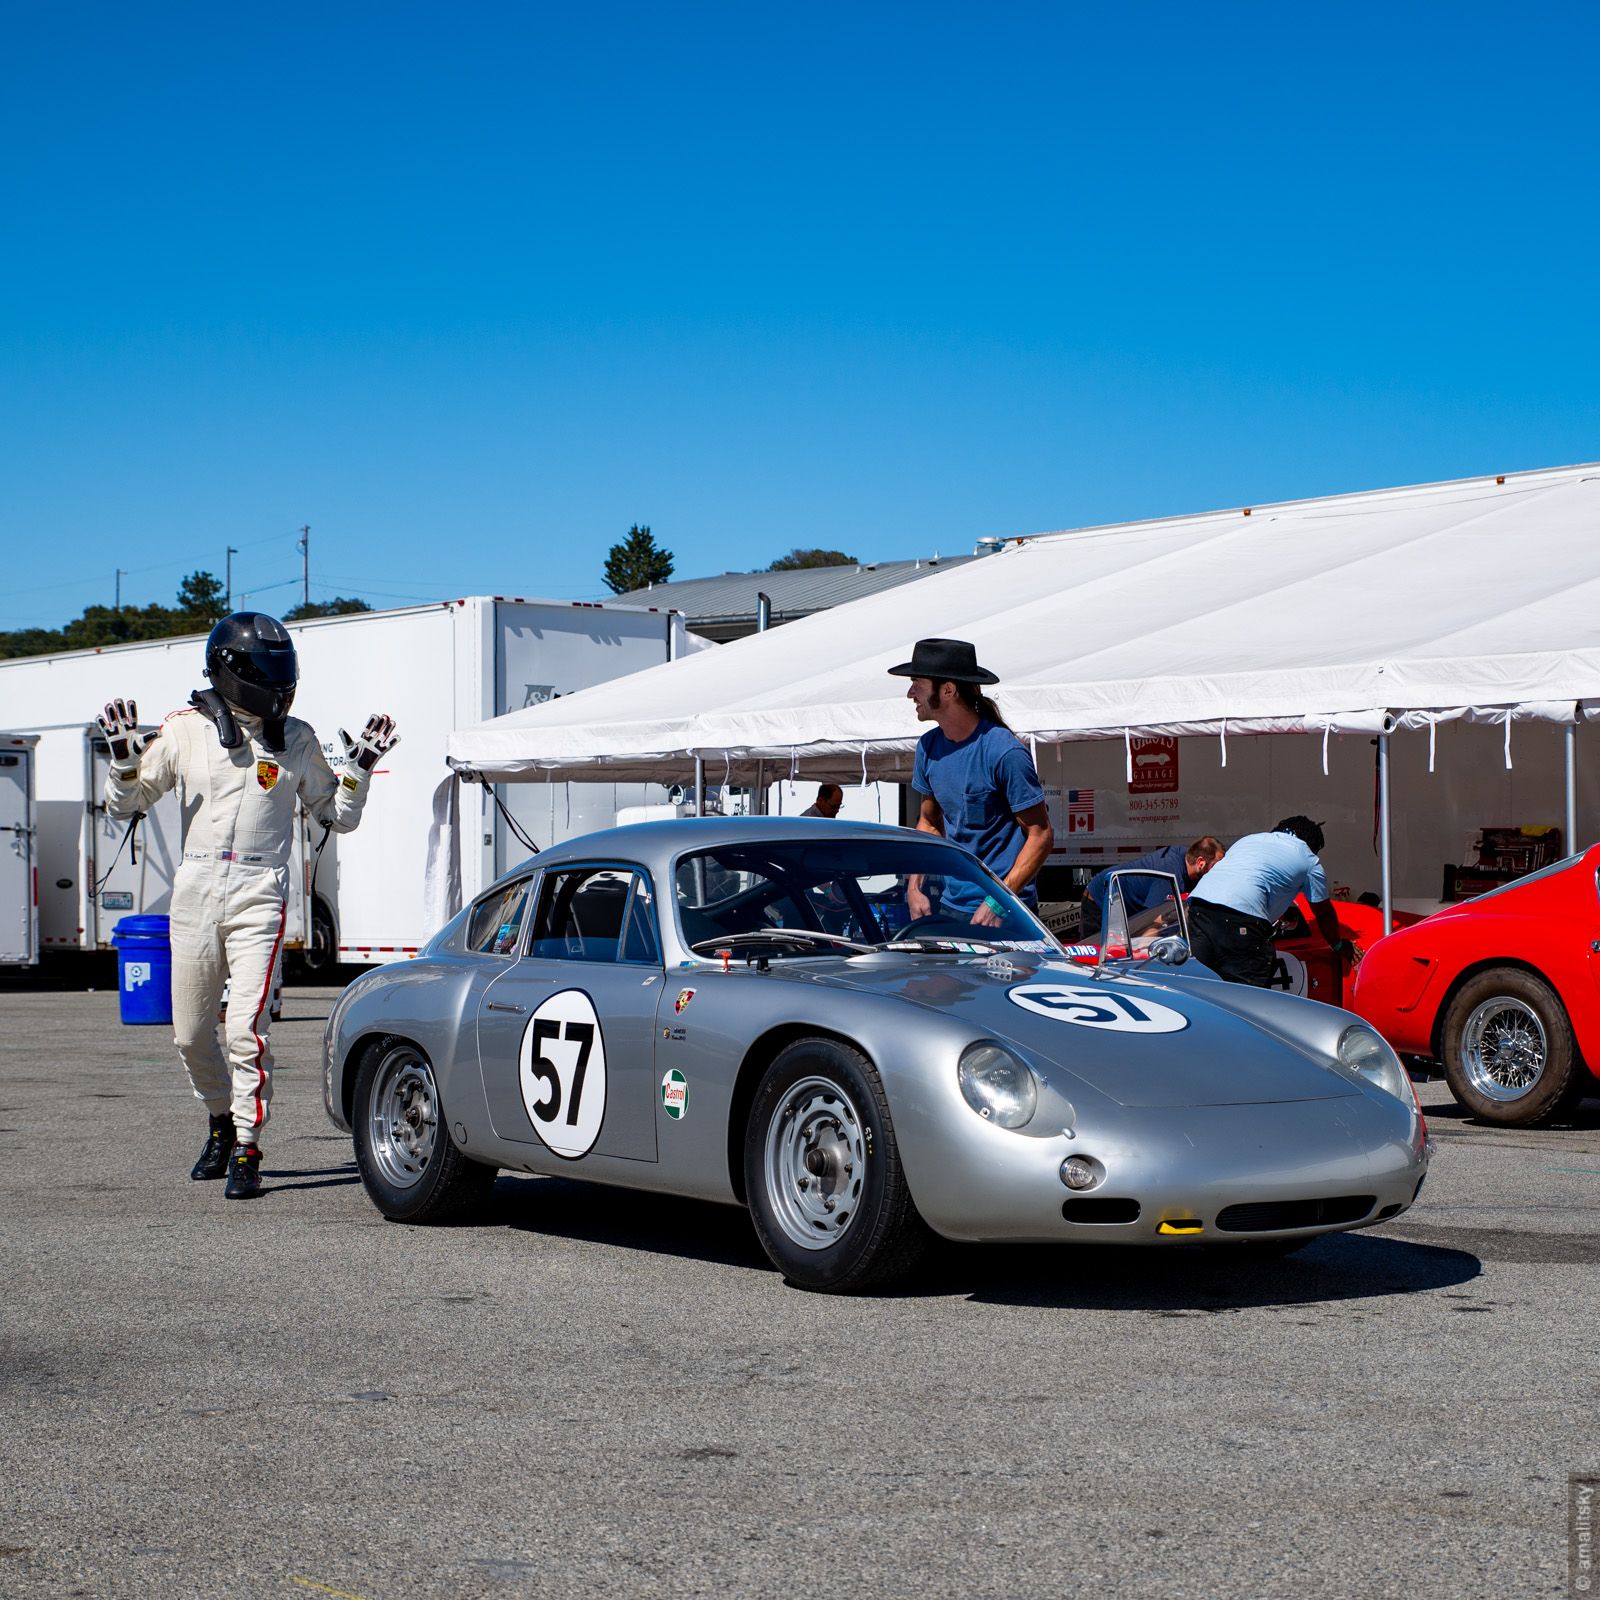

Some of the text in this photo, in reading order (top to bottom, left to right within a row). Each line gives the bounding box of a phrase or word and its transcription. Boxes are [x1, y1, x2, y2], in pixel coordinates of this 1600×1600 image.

[1133, 768, 1173, 780] GARAGE
[1129, 798, 1179, 810] 800-345-5789
[1015, 991, 1152, 1022] 57
[531, 1018, 594, 1126] 57
[665, 1082, 685, 1101] Castrol
